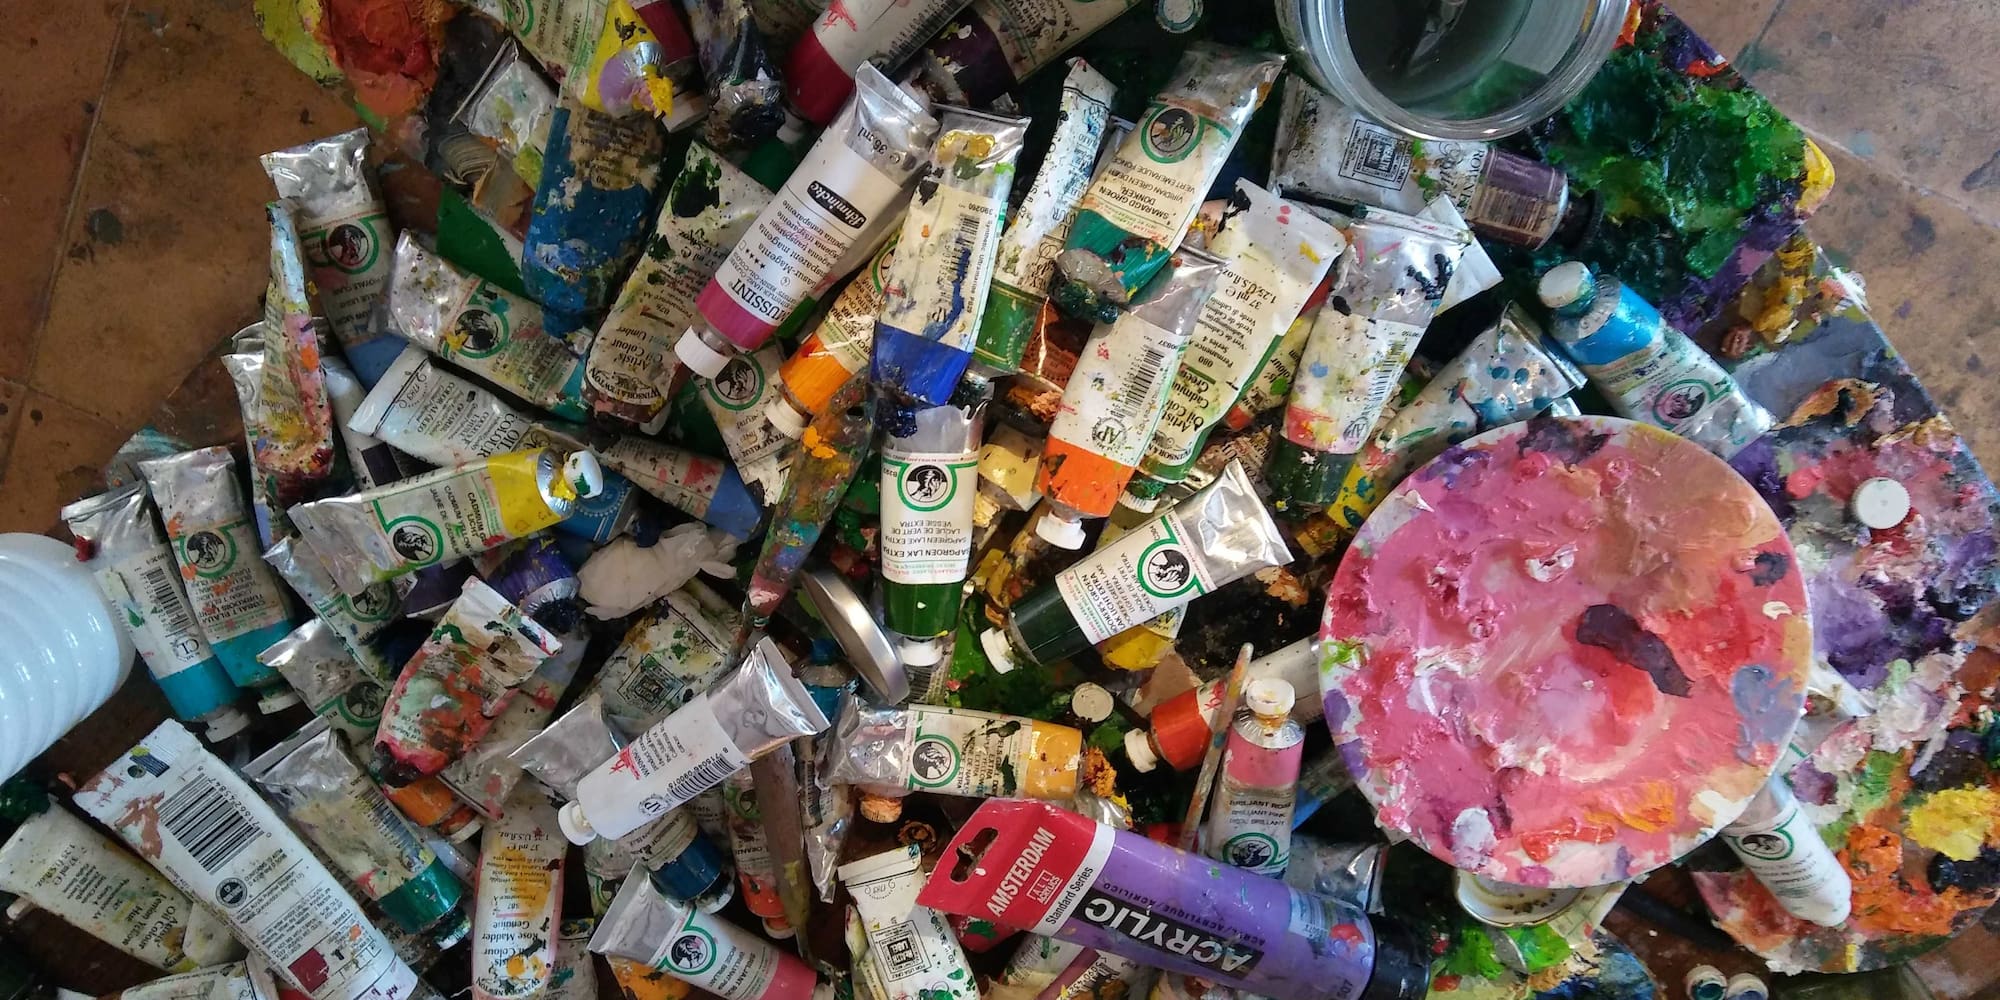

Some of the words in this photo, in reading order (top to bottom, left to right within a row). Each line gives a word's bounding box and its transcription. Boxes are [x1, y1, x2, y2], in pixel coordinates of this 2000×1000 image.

[1128, 175, 1153, 190] GREEN
[1137, 165, 1176, 186] EMERAUDE
[1098, 184, 1128, 205] GROEN
[1153, 185, 1184, 204] VIRIDIAN
[1175, 181, 1194, 194] VERT
[807, 180, 865, 228] Schmincke
[1127, 198, 1169, 221] SMARAGD
[756, 222, 791, 254] magenta
[979, 219, 992, 251] Synthetic
[756, 241, 816, 289] Lasur-Magenta
[969, 253, 984, 294] Ultramarine
[1235, 290, 1250, 303] ml
[1248, 297, 1262, 310] 37
[1234, 320, 1253, 334] Verde
[1238, 311, 1257, 326] Verde
[615, 322, 647, 342] Umber
[610, 336, 645, 357] Colour
[1193, 340, 1234, 367] Permanence
[1208, 338, 1229, 354] Series
[613, 350, 649, 372] Artists'
[1197, 354, 1214, 367] 080
[434, 380, 455, 405] COLOR
[1170, 381, 1210, 408] Cadmiu
[428, 403, 439, 414] AL
[1159, 409, 1191, 434] Artist
[477, 411, 516, 460] COLOUR
[497, 427, 520, 454] OIL
[443, 484, 462, 519] CADMIUM
[466, 490, 485, 531] CADMIUM
[439, 509, 448, 521] DE
[466, 513, 479, 538] LICHT
[890, 526, 900, 534] DE
[884, 534, 905, 544] EXTRA
[882, 545, 904, 557] EXTRA
[906, 549, 923, 557] LAK
[1095, 562, 1108, 579] LAKE
[1119, 551, 1134, 573] EXTRA
[1089, 571, 1106, 595] EXTRA
[1116, 565, 1129, 582] VERT
[1080, 573, 1099, 602] GROEN
[1103, 578, 1119, 600] GREEN
[1109, 574, 1125, 594] EXTRA
[1124, 580, 1135, 592] DE
[231, 598, 266, 615] COBALT
[1101, 594, 1117, 616] LICHT
[1120, 593, 1135, 613] LIGHT
[1113, 615, 1125, 630] LAK
[985, 753, 995, 779] EXTRA
[643, 797, 663, 816] AP
[984, 825, 1056, 918] AMSTERDAM
[1045, 888, 1076, 926] Standard
[1069, 864, 1094, 892] Series
[124, 904, 142, 924] Hue
[141, 892, 166, 921] Lemon
[160, 904, 176, 921] Oil
[137, 918, 165, 951] Colour
[492, 920, 530, 929] Genuine
[481, 932, 514, 942] Madder
[517, 932, 538, 940] Rose
[1082, 895, 1251, 975] ACRYLIC
[483, 947, 515, 957] Colour
